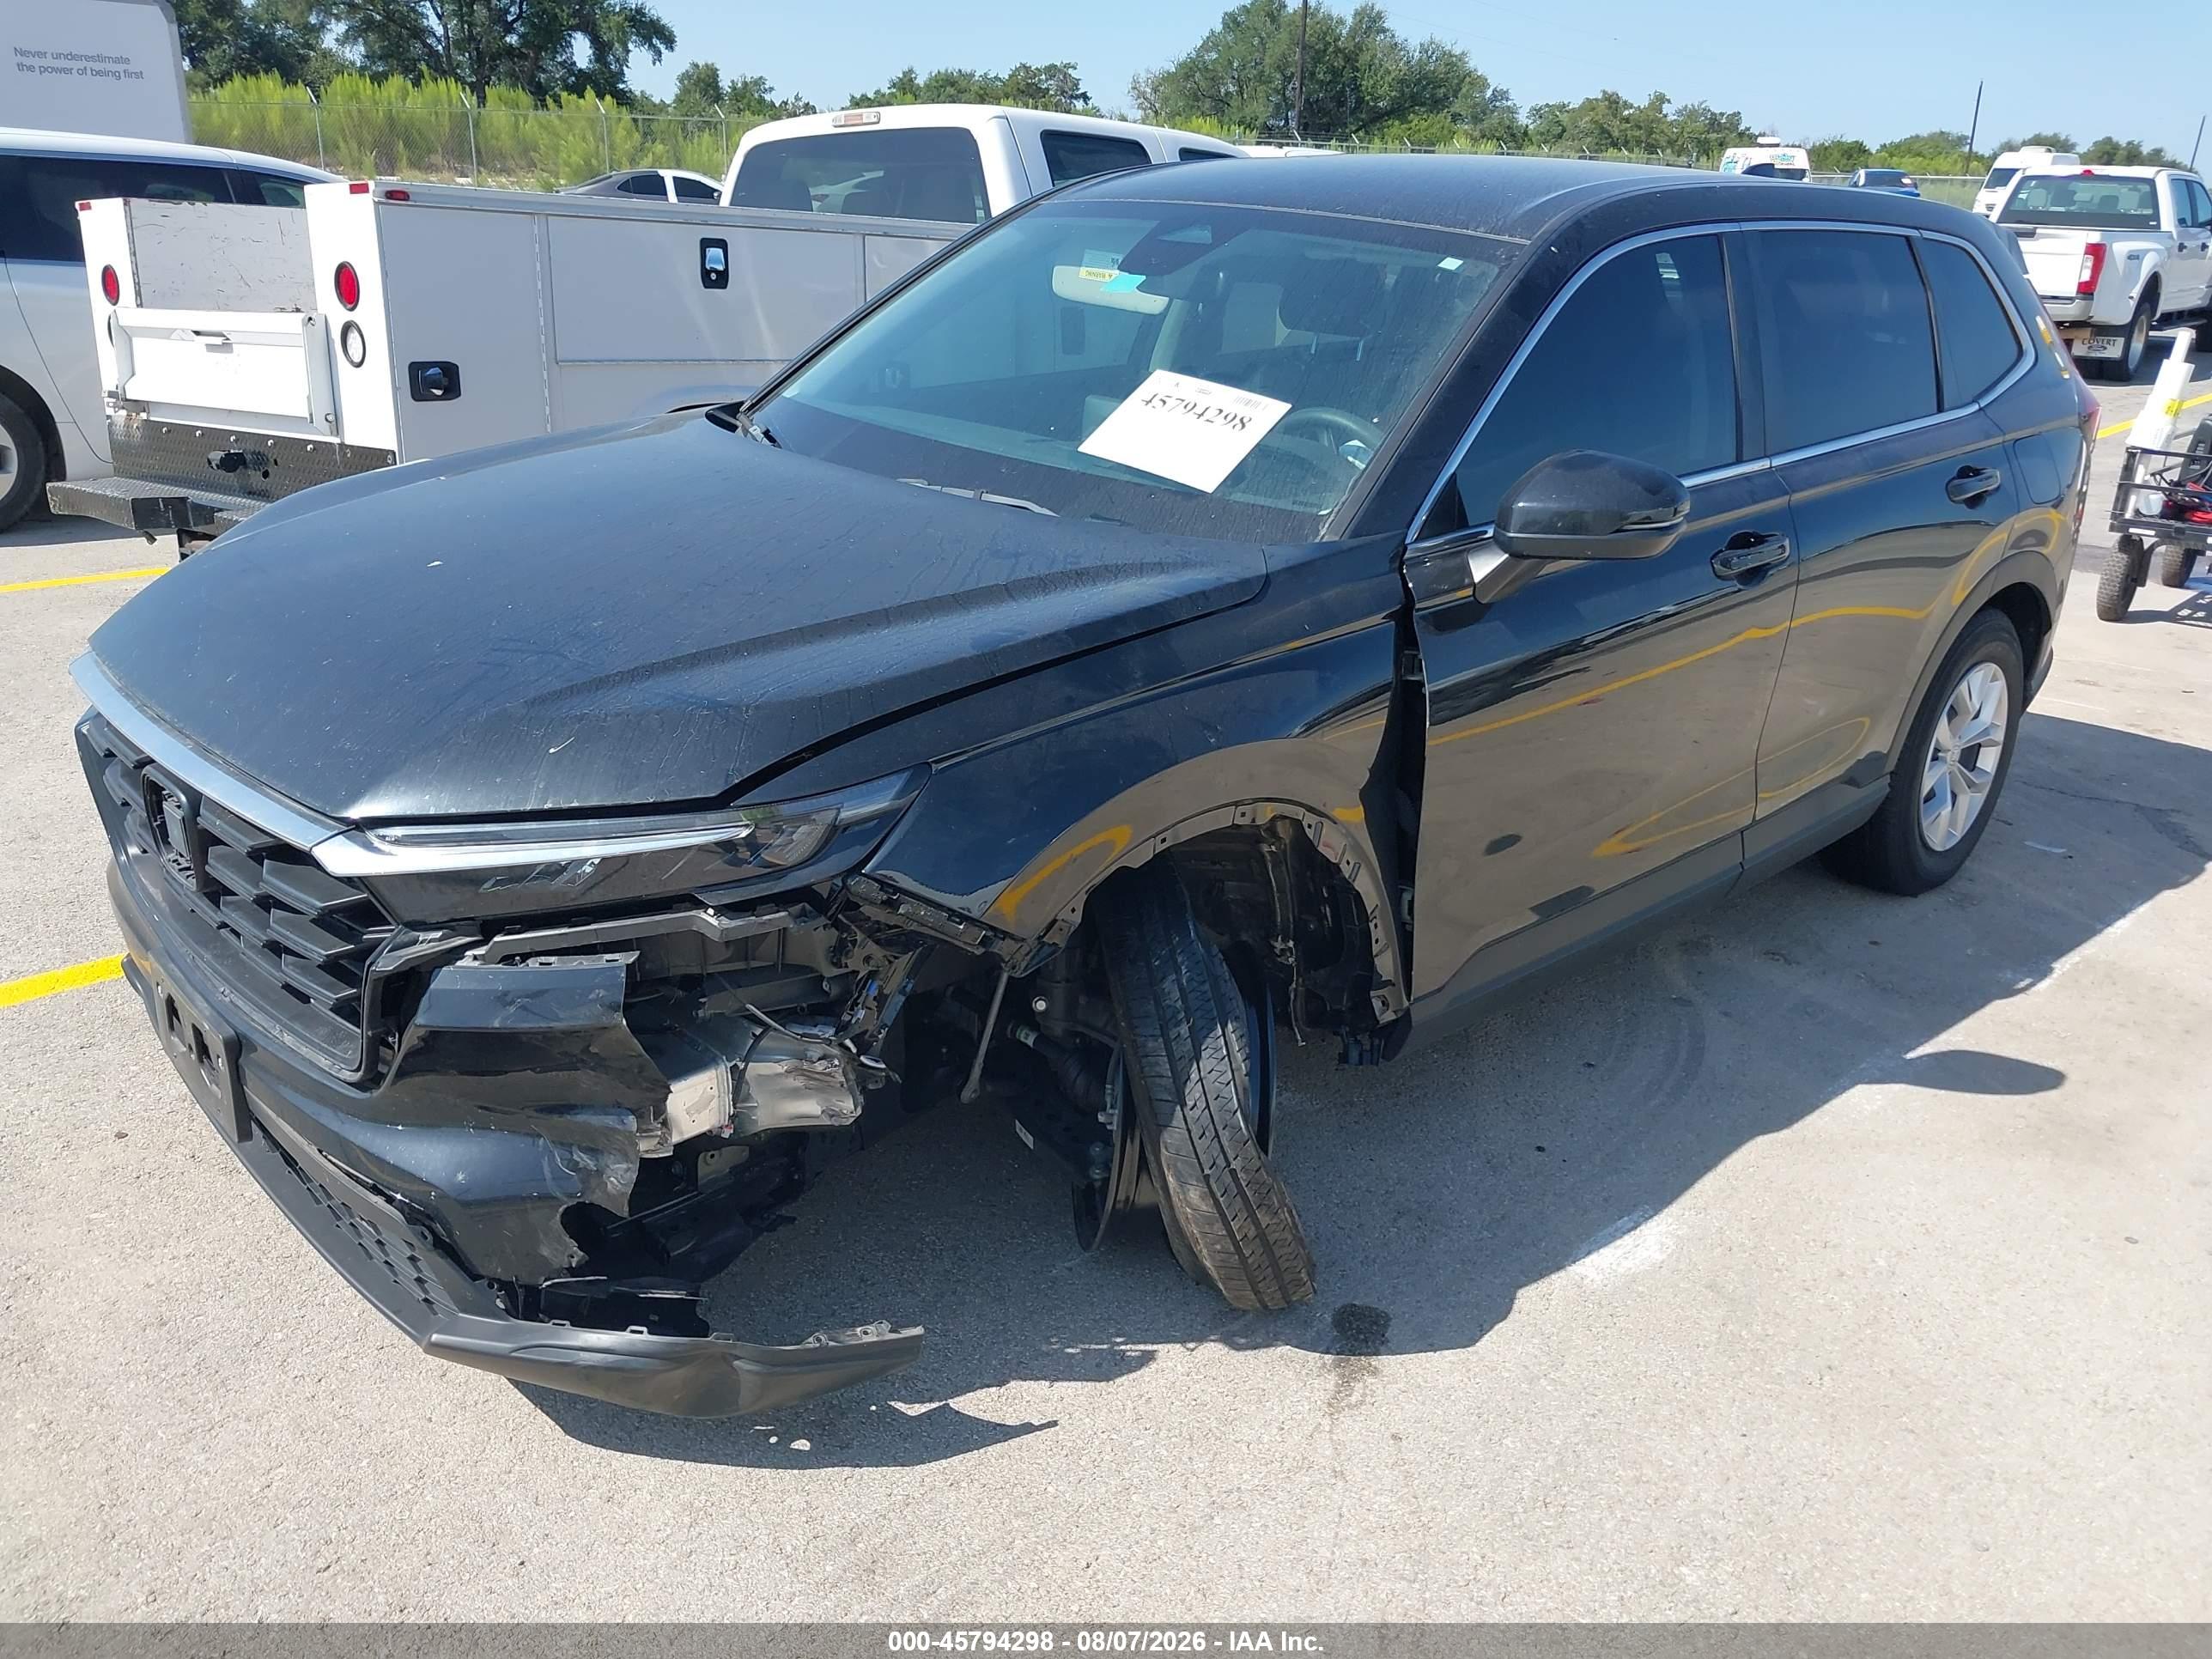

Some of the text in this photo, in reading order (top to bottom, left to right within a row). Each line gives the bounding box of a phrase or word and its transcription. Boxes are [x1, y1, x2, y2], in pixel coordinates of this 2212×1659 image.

[13, 46, 131, 65] Never underestimate
[16, 61, 144, 81] the power of being first
[2081, 337, 2117, 347] COVERT
[1140, 392, 1253, 432] 45794298
